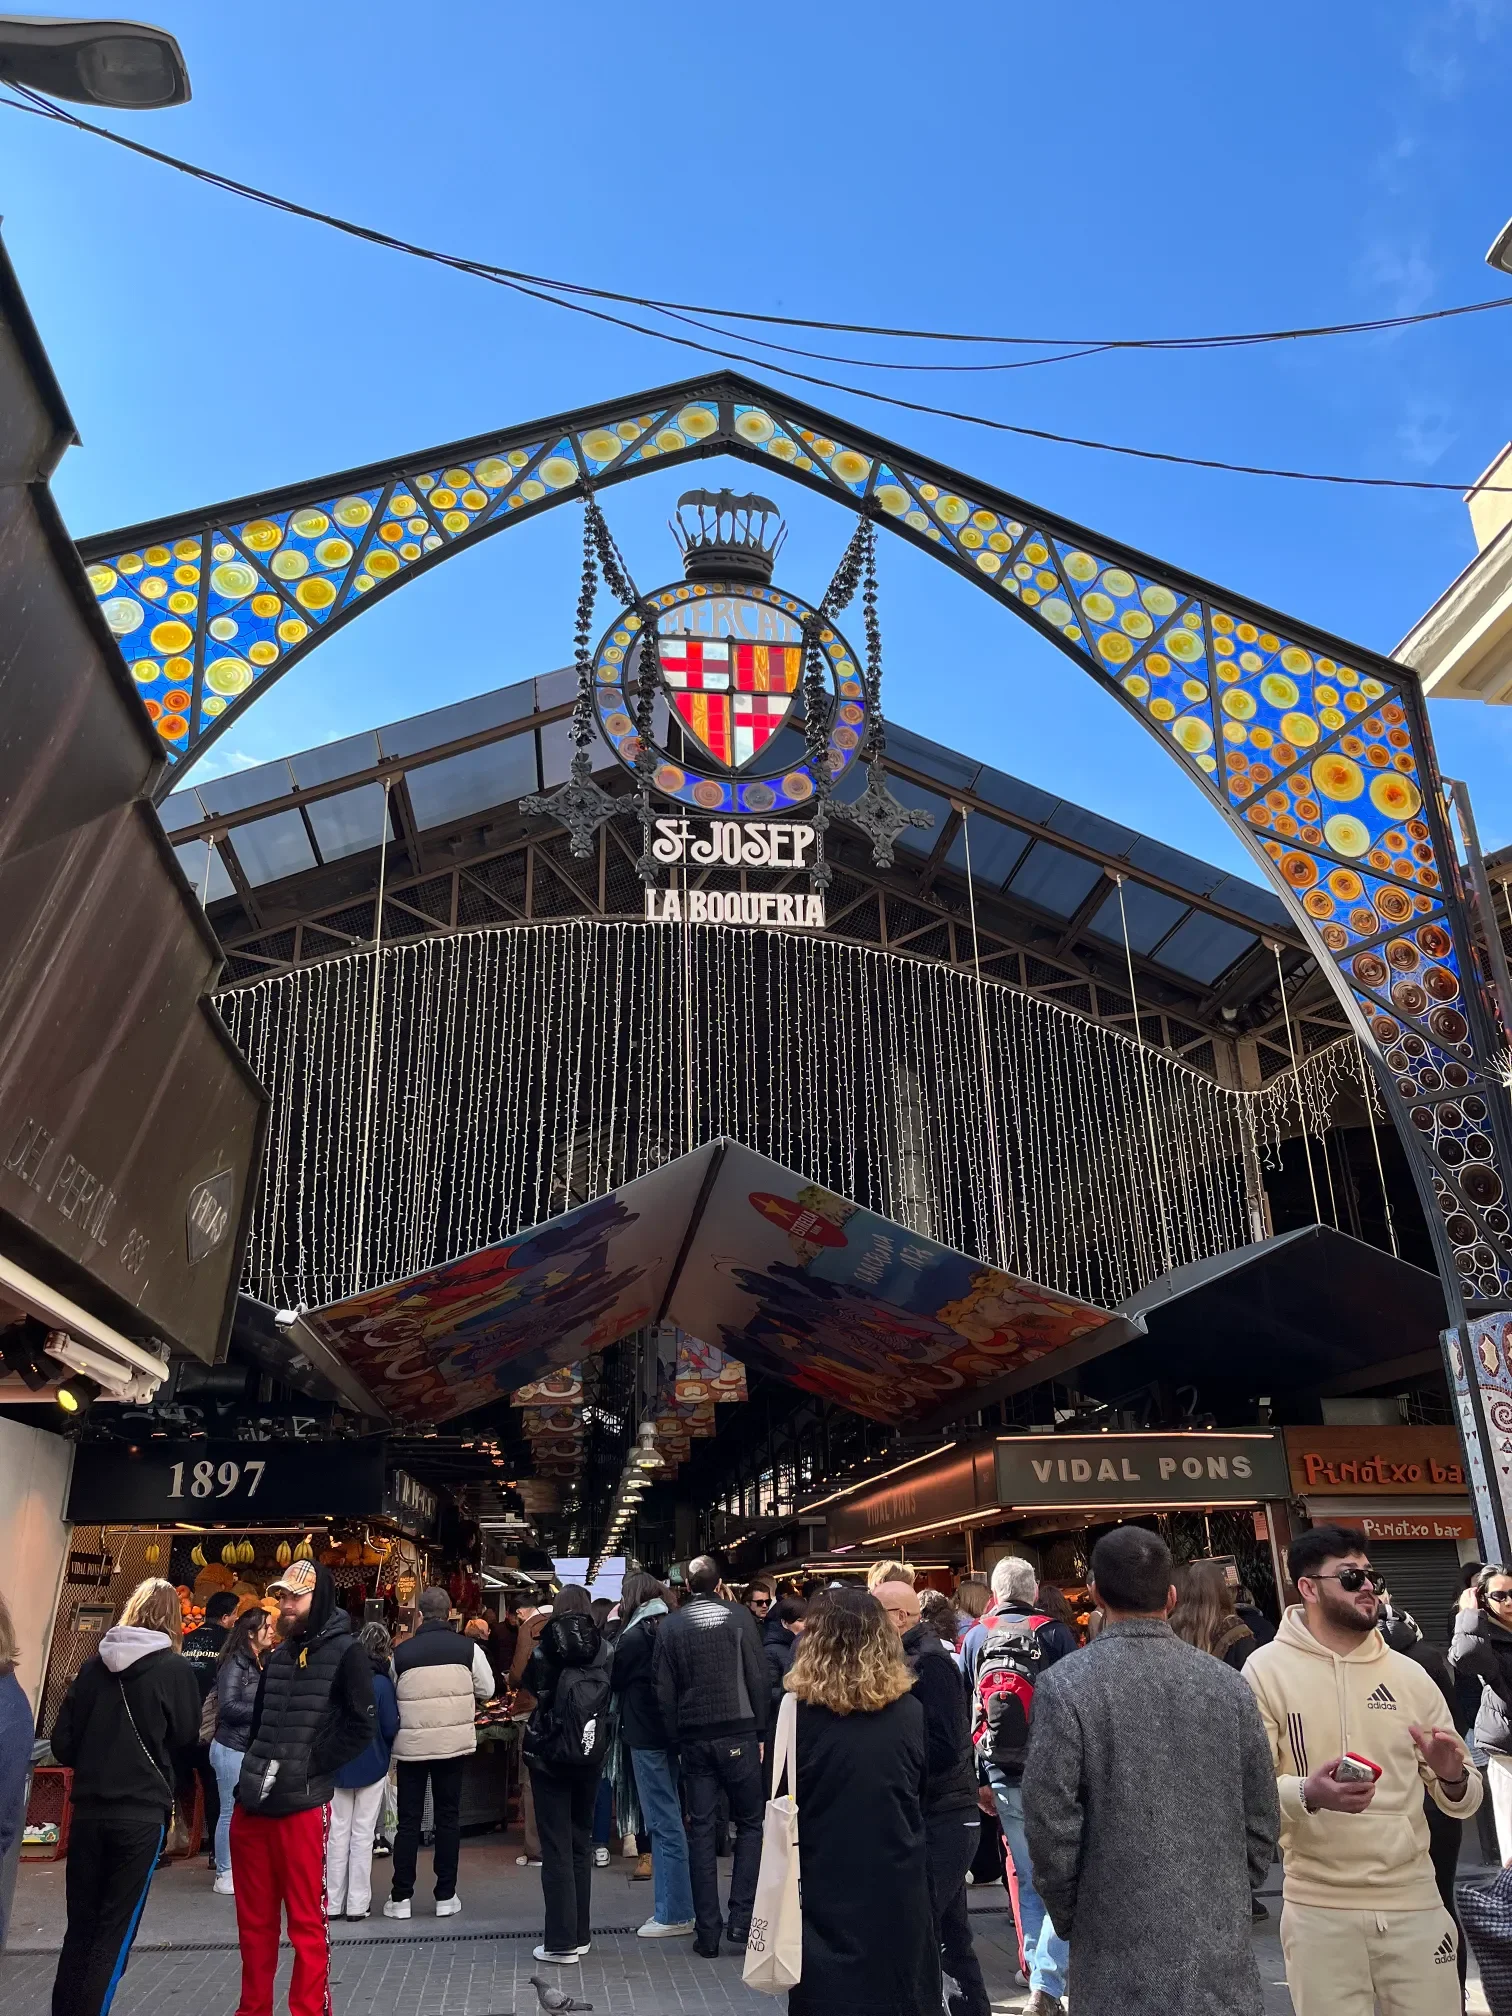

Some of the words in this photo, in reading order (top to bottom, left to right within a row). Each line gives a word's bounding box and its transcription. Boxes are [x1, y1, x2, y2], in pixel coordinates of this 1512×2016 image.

[663, 598, 797, 643] MERCAT
[690, 820, 815, 867] JOSEP
[646, 888, 682, 922] LA
[689, 890, 826, 927] BOQUERIA
[3, 1116, 56, 1193] DEL
[47, 1154, 117, 1247] PERNIL
[789, 1210, 820, 1237] ESTRELLA
[853, 1233, 895, 1285] BARCELONA
[166, 1460, 267, 1498] 1897
[1031, 1457, 1140, 1484] VIDAL
[1158, 1455, 1253, 1481] PONS
[1429, 1457, 1468, 1484] ba
[866, 1498, 890, 1528] VIDAL
[892, 1488, 916, 1519] PONS
[1433, 1522, 1463, 1538] bar
[1367, 1701, 1397, 1711] adidas
